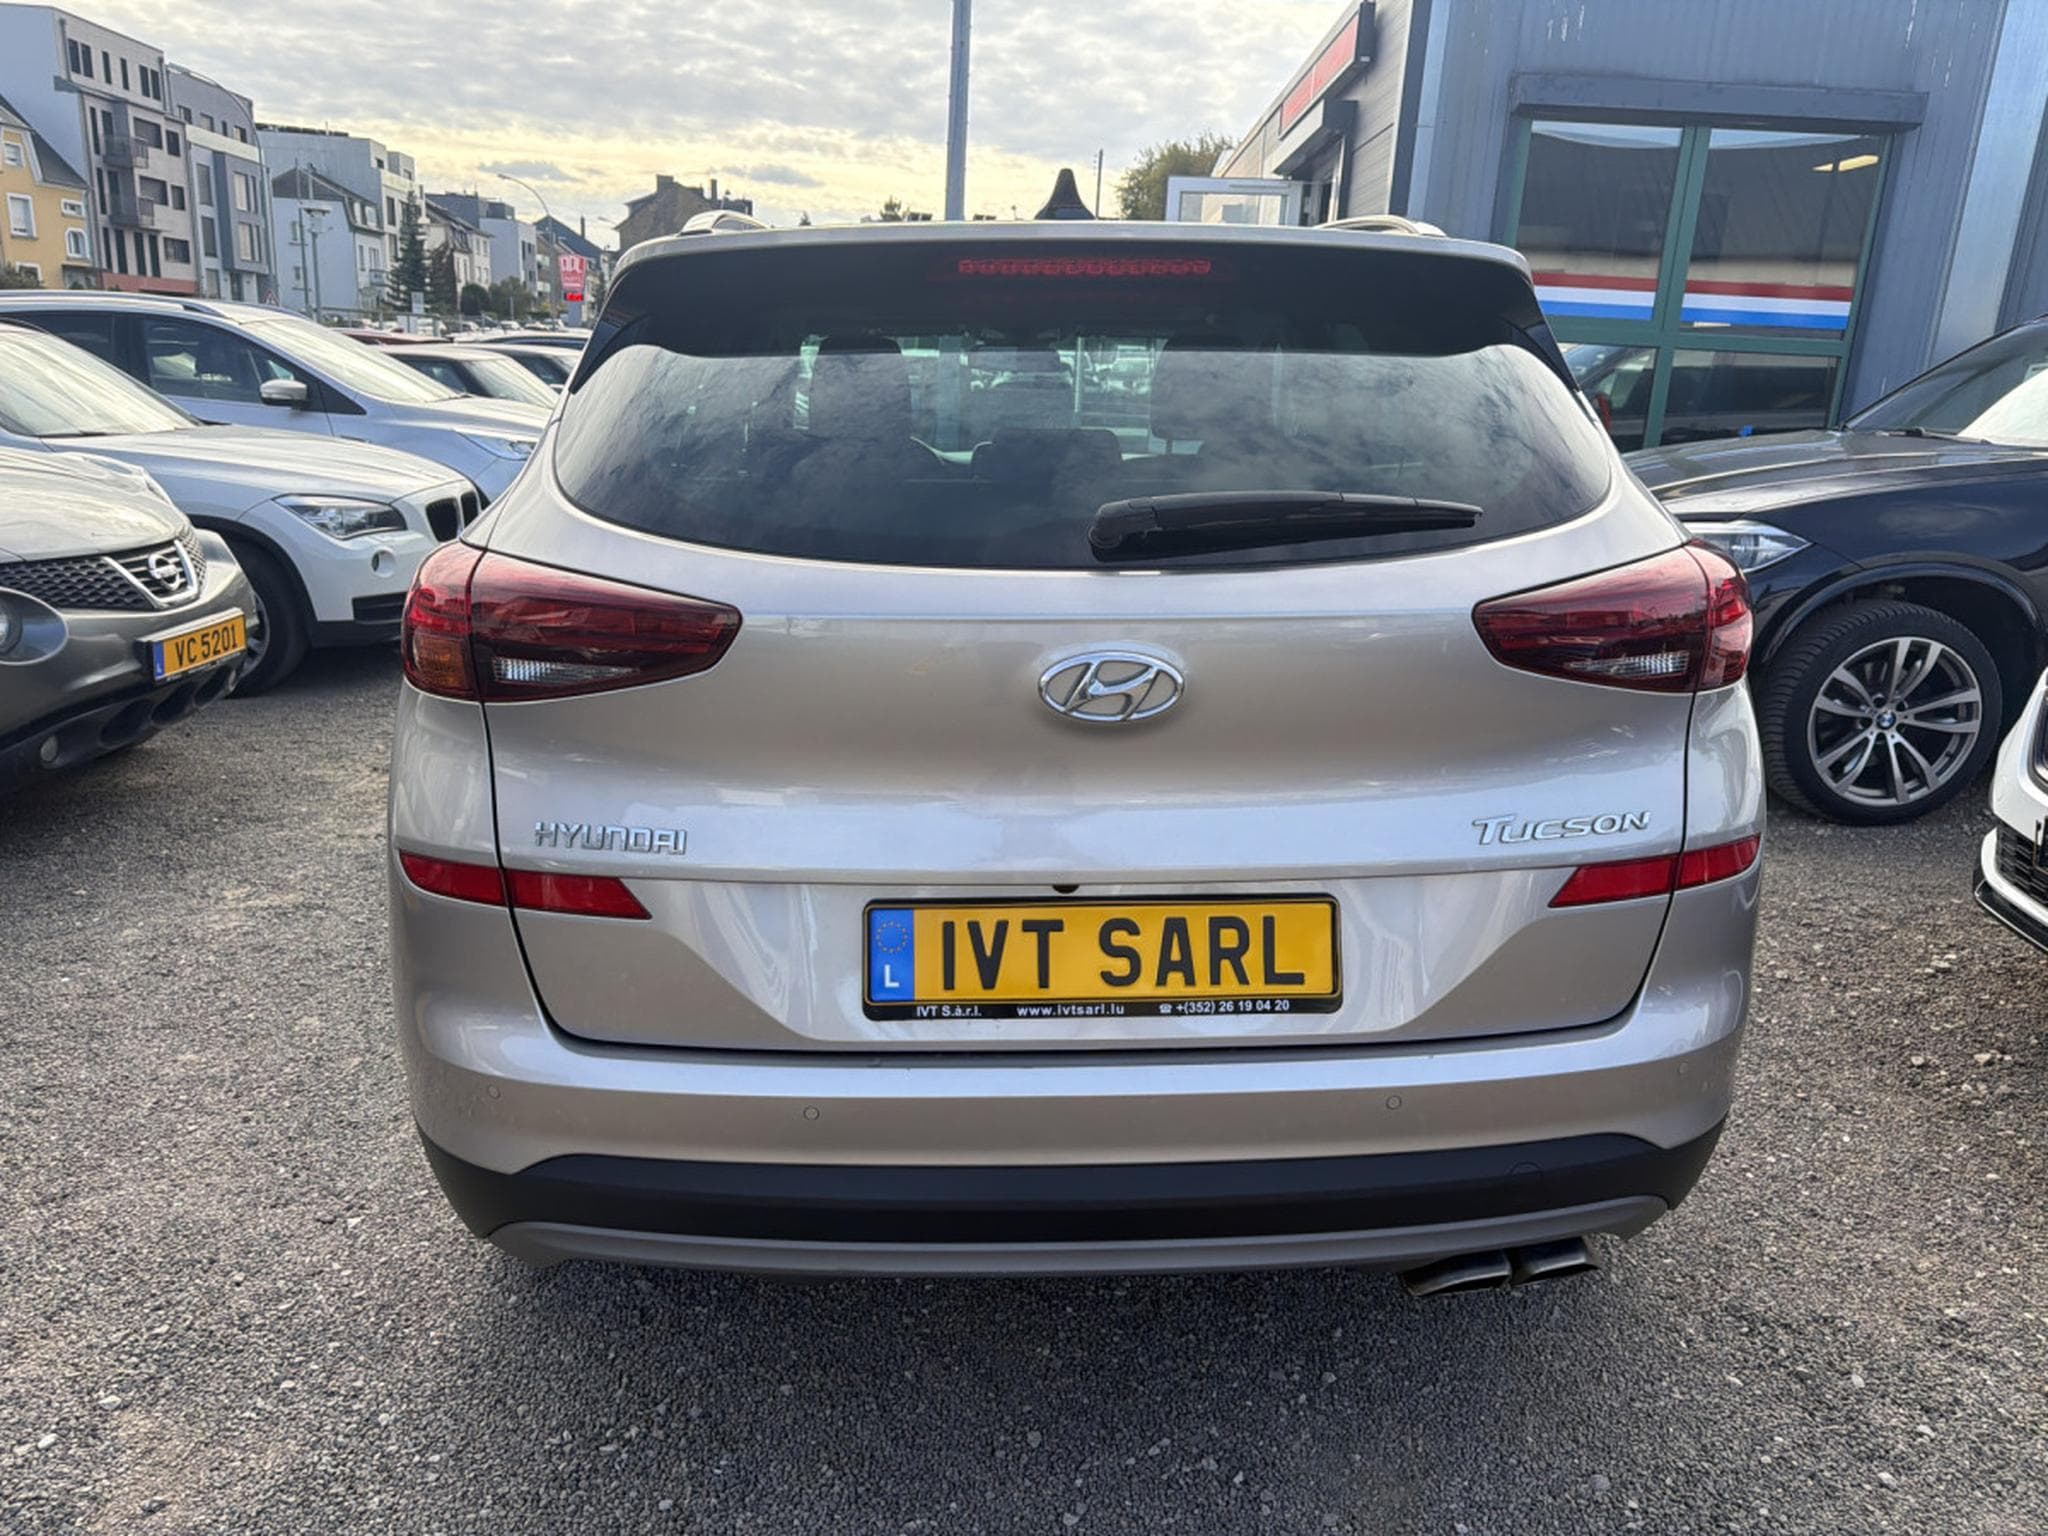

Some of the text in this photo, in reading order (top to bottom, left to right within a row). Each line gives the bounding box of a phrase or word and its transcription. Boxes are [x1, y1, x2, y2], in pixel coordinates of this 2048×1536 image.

[175, 624, 238, 666] VC 5201
[534, 821, 688, 856] HYUNDAI
[942, 916, 1306, 990] IVT SARL
[884, 964, 900, 988] L
[916, 1004, 983, 1017] IVT S.à.r.l.
[1016, 1003, 1125, 1017] www.ivtsarl.lu
[1176, 999, 1290, 1014] +(352) 26 19 04 20
